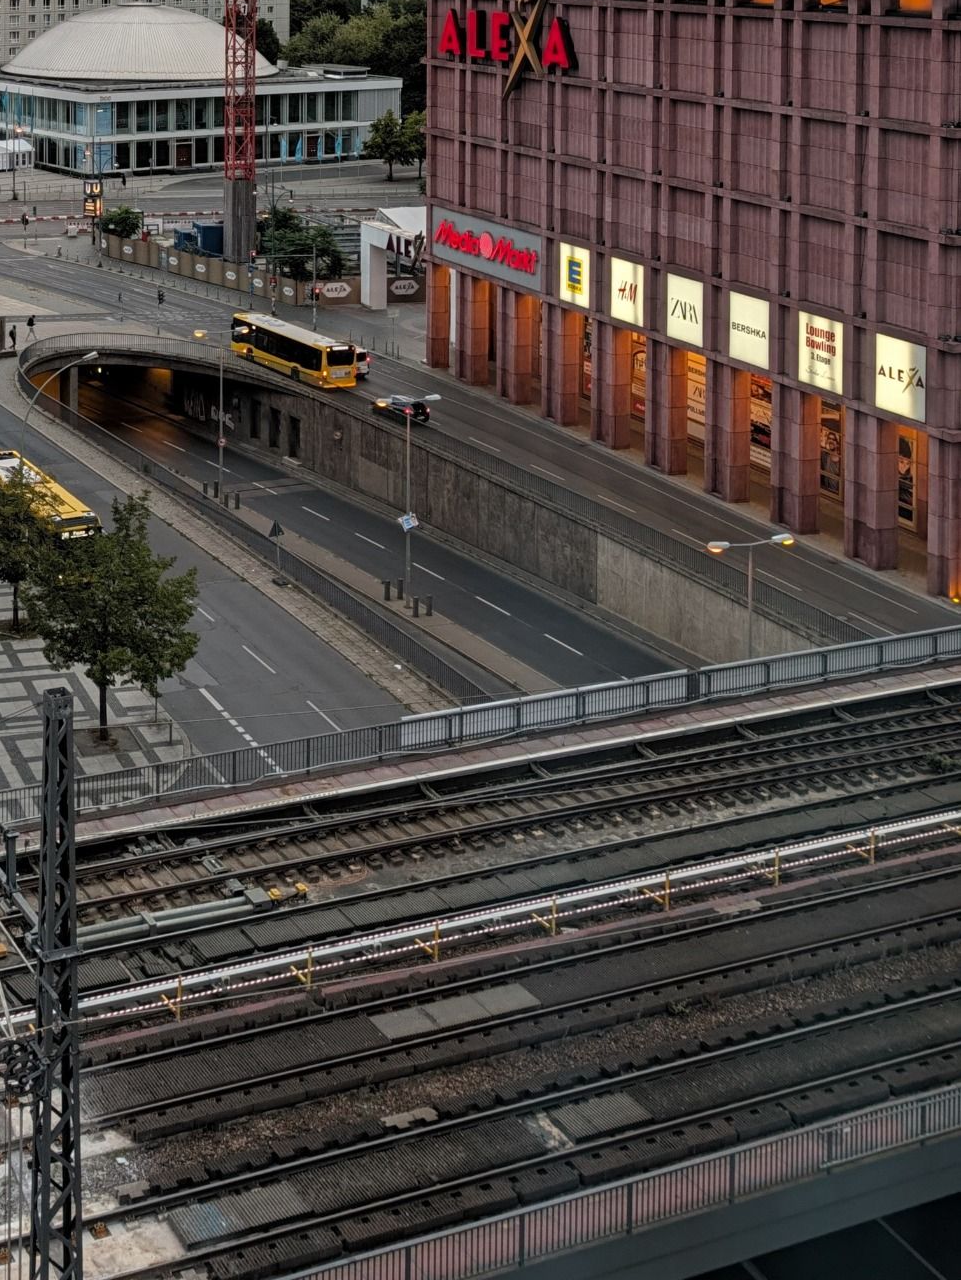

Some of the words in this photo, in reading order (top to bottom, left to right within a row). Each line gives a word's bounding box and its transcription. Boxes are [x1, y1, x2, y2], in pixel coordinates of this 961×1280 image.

[93, 183, 100, 192] U
[434, 219, 480, 258] Media
[490, 237, 538, 275] Markt
[618, 280, 637, 304] H&M
[670, 297, 698, 325] ZARA
[731, 321, 767, 339] BERSHKA
[806, 322, 835, 343] Lounge
[805, 336, 836, 357] Bowling
[878, 365, 925, 394] ALEXA
